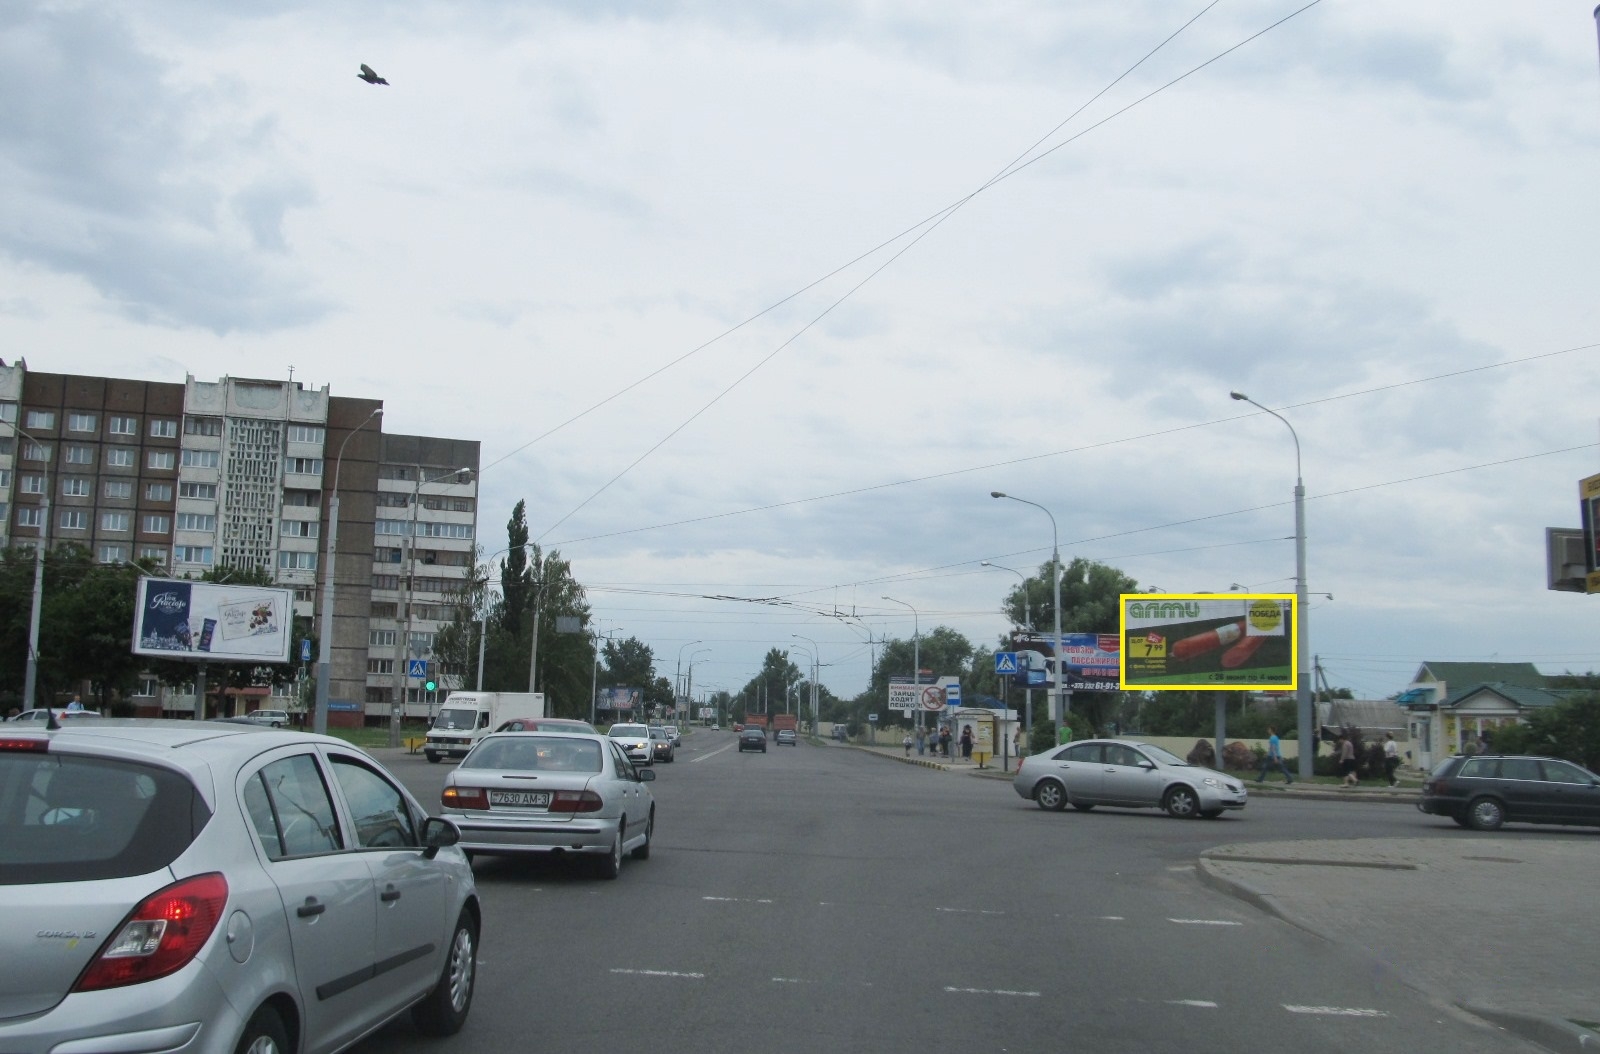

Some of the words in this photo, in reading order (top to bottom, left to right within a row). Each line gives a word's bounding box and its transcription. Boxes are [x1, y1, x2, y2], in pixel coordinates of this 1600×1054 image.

[1248, 610, 1282, 618] ПОБЕДА
[1095, 681, 1119, 690] 61-91-3
[498, 792, 520, 804] 7630
[35, 930, 80, 939] CORSA
